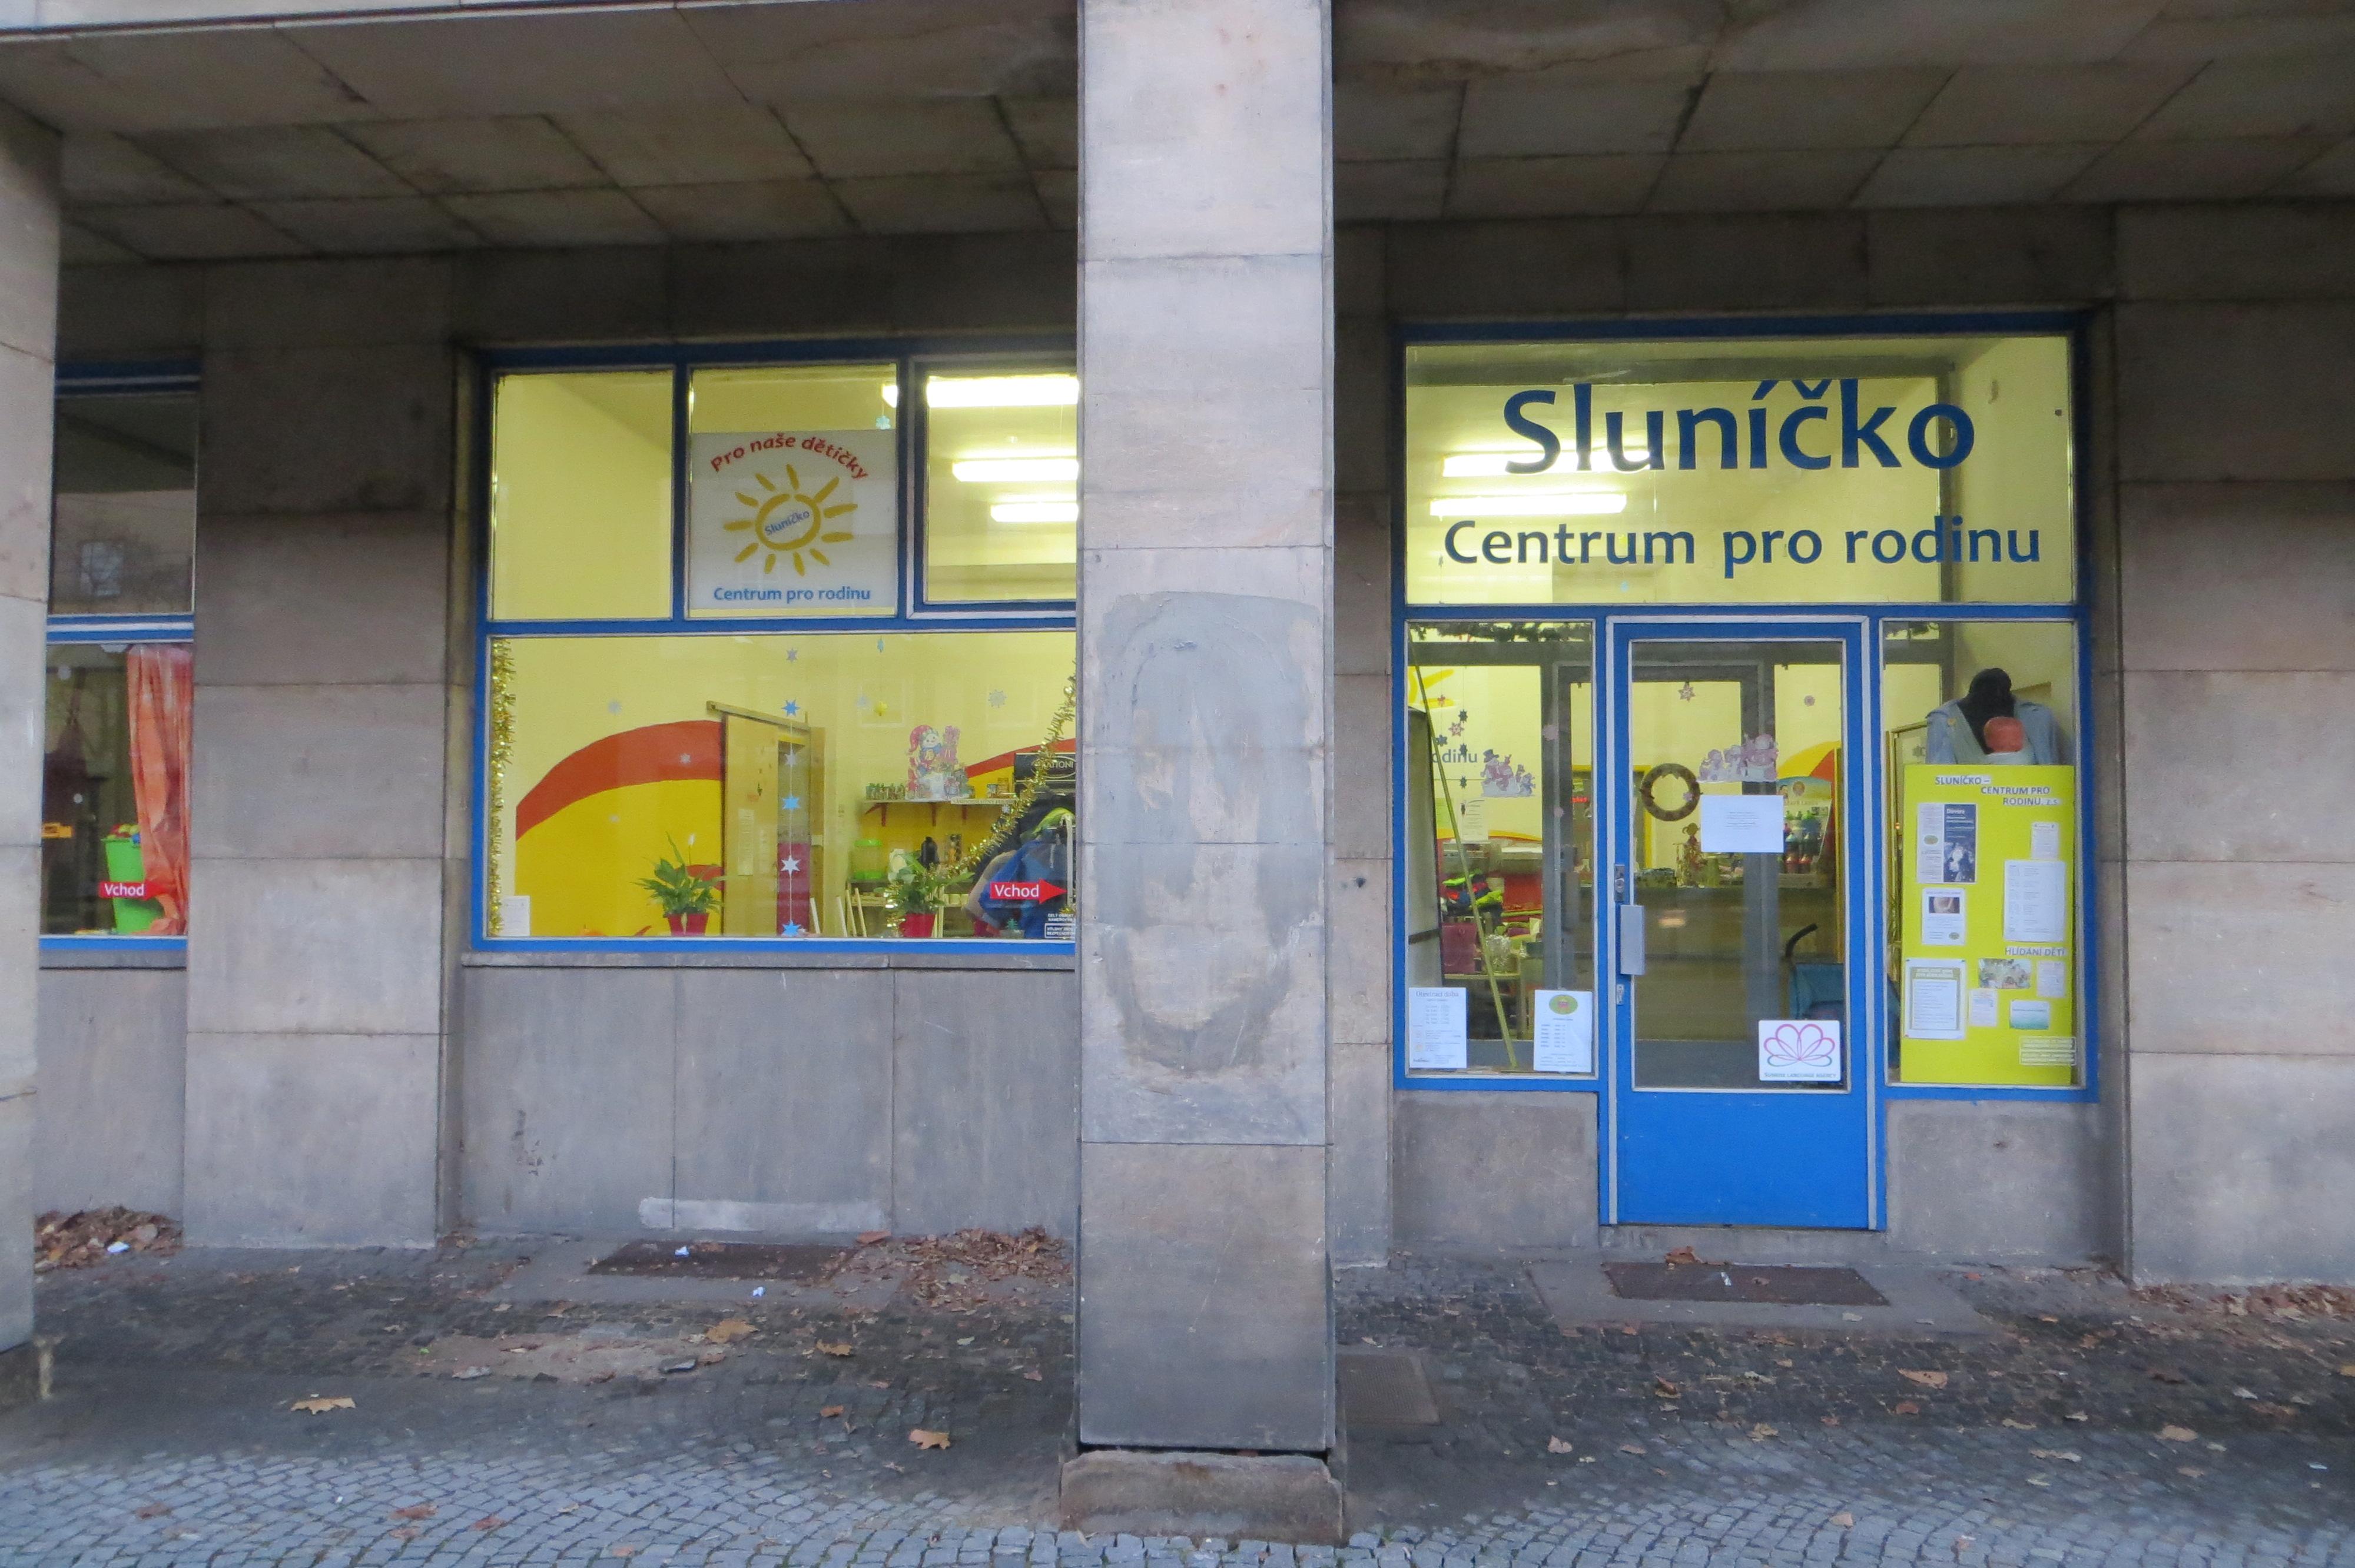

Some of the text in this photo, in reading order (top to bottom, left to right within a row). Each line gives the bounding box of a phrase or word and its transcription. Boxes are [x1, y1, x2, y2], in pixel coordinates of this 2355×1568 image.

[1503, 378, 1975, 474] Sluníčko
[711, 433, 869, 481] Pro naše dětičky
[765, 509, 810, 536] Sluníčko
[1444, 515, 2040, 579] Centrum pro rodinu
[714, 586, 871, 604] Centrum pro rodinu
[1432, 749, 1478, 763] odinu
[1935, 775, 1982, 785] SLUNÍČKO
[1981, 786, 2050, 795] CENTRUM PRO
[104, 882, 144, 896] Vchod
[994, 884, 1039, 897] Vchod
